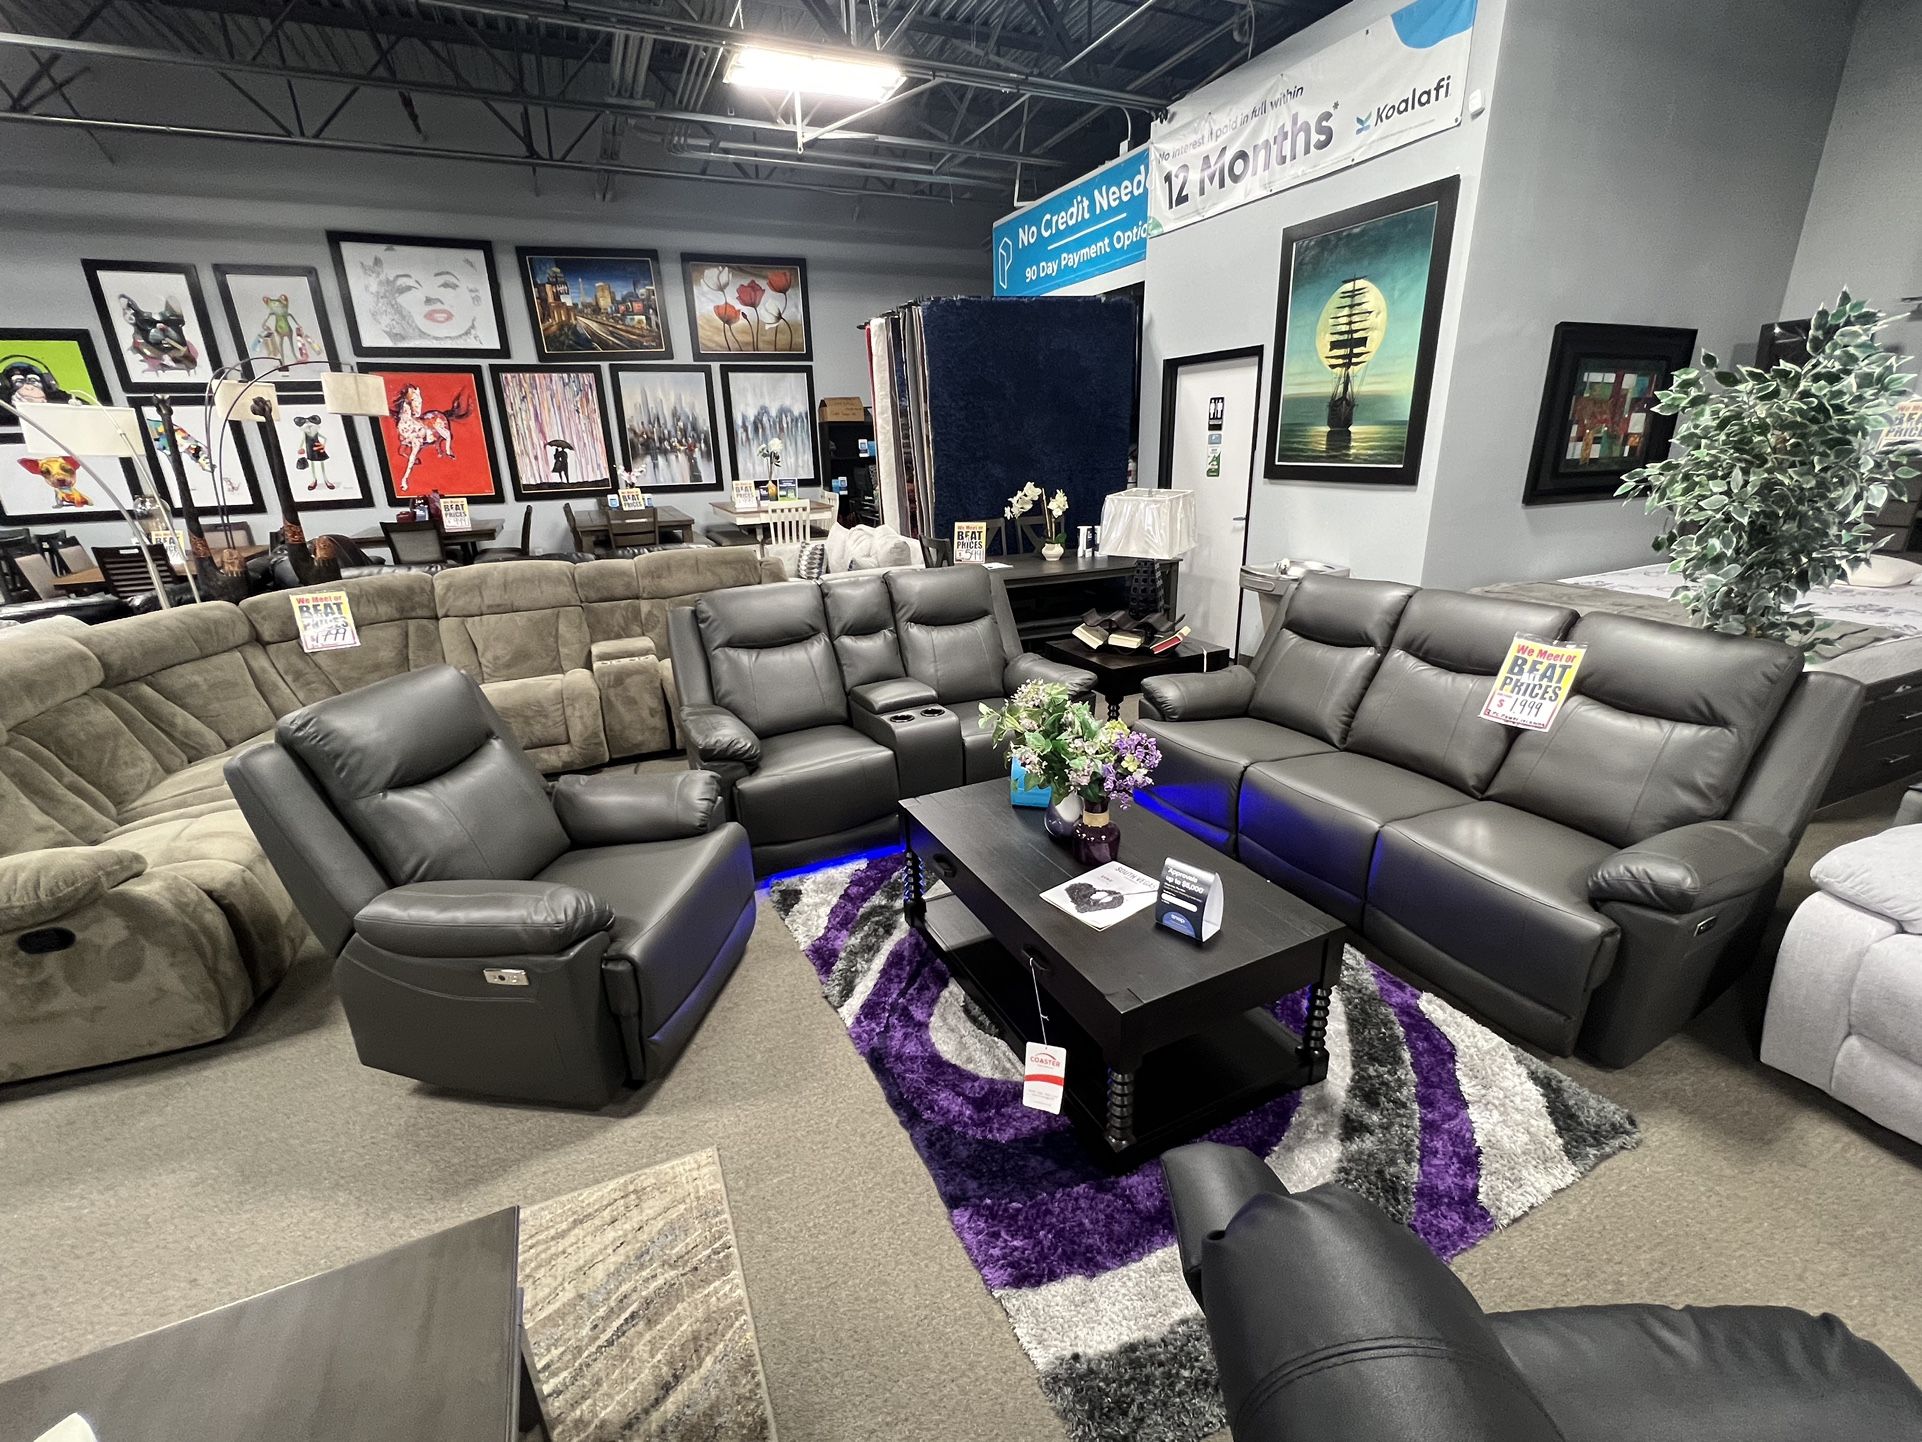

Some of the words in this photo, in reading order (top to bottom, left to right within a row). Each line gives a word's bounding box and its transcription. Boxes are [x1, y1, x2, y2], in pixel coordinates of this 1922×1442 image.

[1374, 75, 1452, 127] Koalafi
[1159, 151, 1170, 164] No
[1171, 134, 1205, 159] interest
[1215, 118, 1238, 143] paid
[1239, 113, 1249, 128] in
[1250, 99, 1267, 121] full
[1270, 85, 1304, 112] within
[1163, 163, 1190, 211] 12
[1018, 224, 1037, 249] No
[1041, 195, 1090, 238] Credit
[1025, 265, 1037, 282] 90
[1039, 259, 1058, 278] Day
[1061, 237, 1111, 269] Payment
[957, 531, 983, 540] BEAT
[957, 541, 983, 549] PRICES
[1516, 644, 1535, 656] We
[1536, 649, 1564, 662] Meet
[1565, 655, 1577, 663] or
[1506, 655, 1572, 685] BEAT
[1499, 676, 1562, 702] PRICES
[1165, 875, 1174, 884] up
[1174, 877, 1181, 885] to
[1029, 1056, 1061, 1067] COASTER
